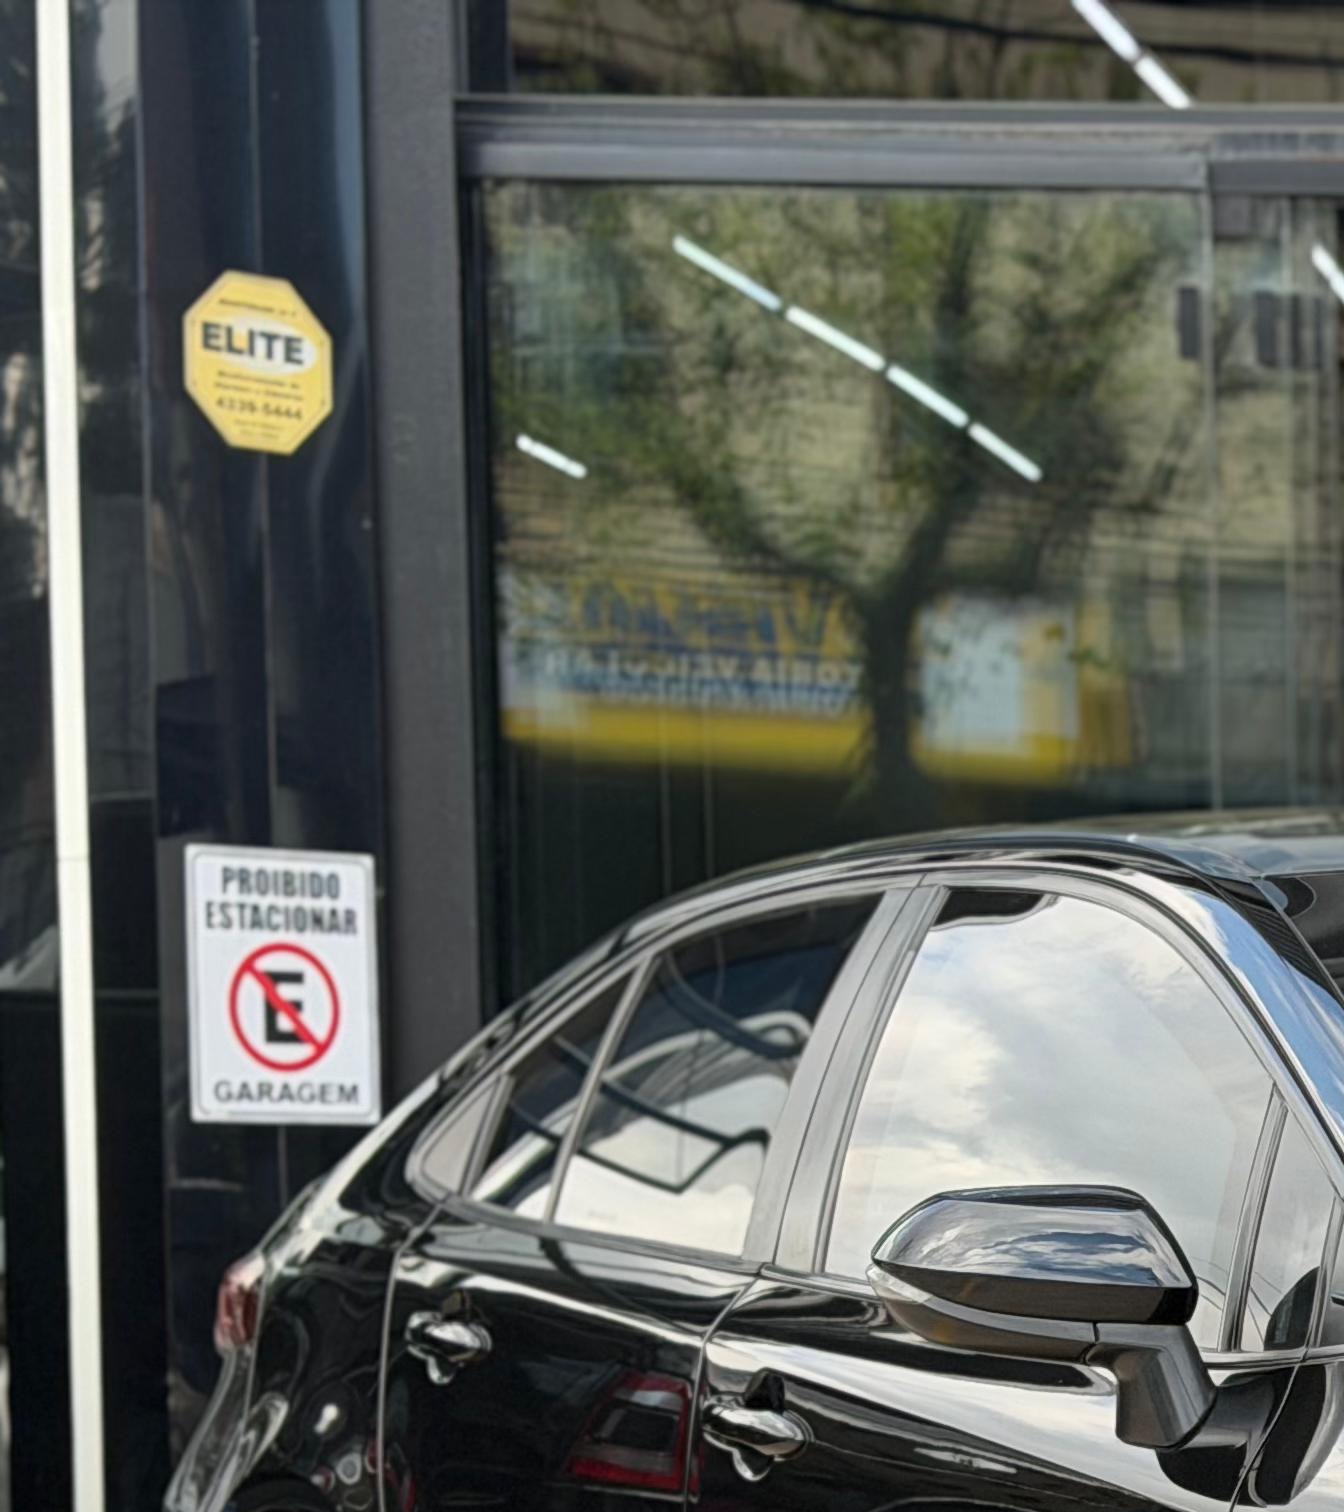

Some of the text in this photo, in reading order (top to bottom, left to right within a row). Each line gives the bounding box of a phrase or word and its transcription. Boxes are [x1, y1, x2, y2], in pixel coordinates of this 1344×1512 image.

[201, 321, 304, 366] ELITE
[221, 867, 340, 899] PROIBIDO
[206, 901, 358, 935] ESTACIONAR
[213, 1080, 359, 1105] GARAGEM
